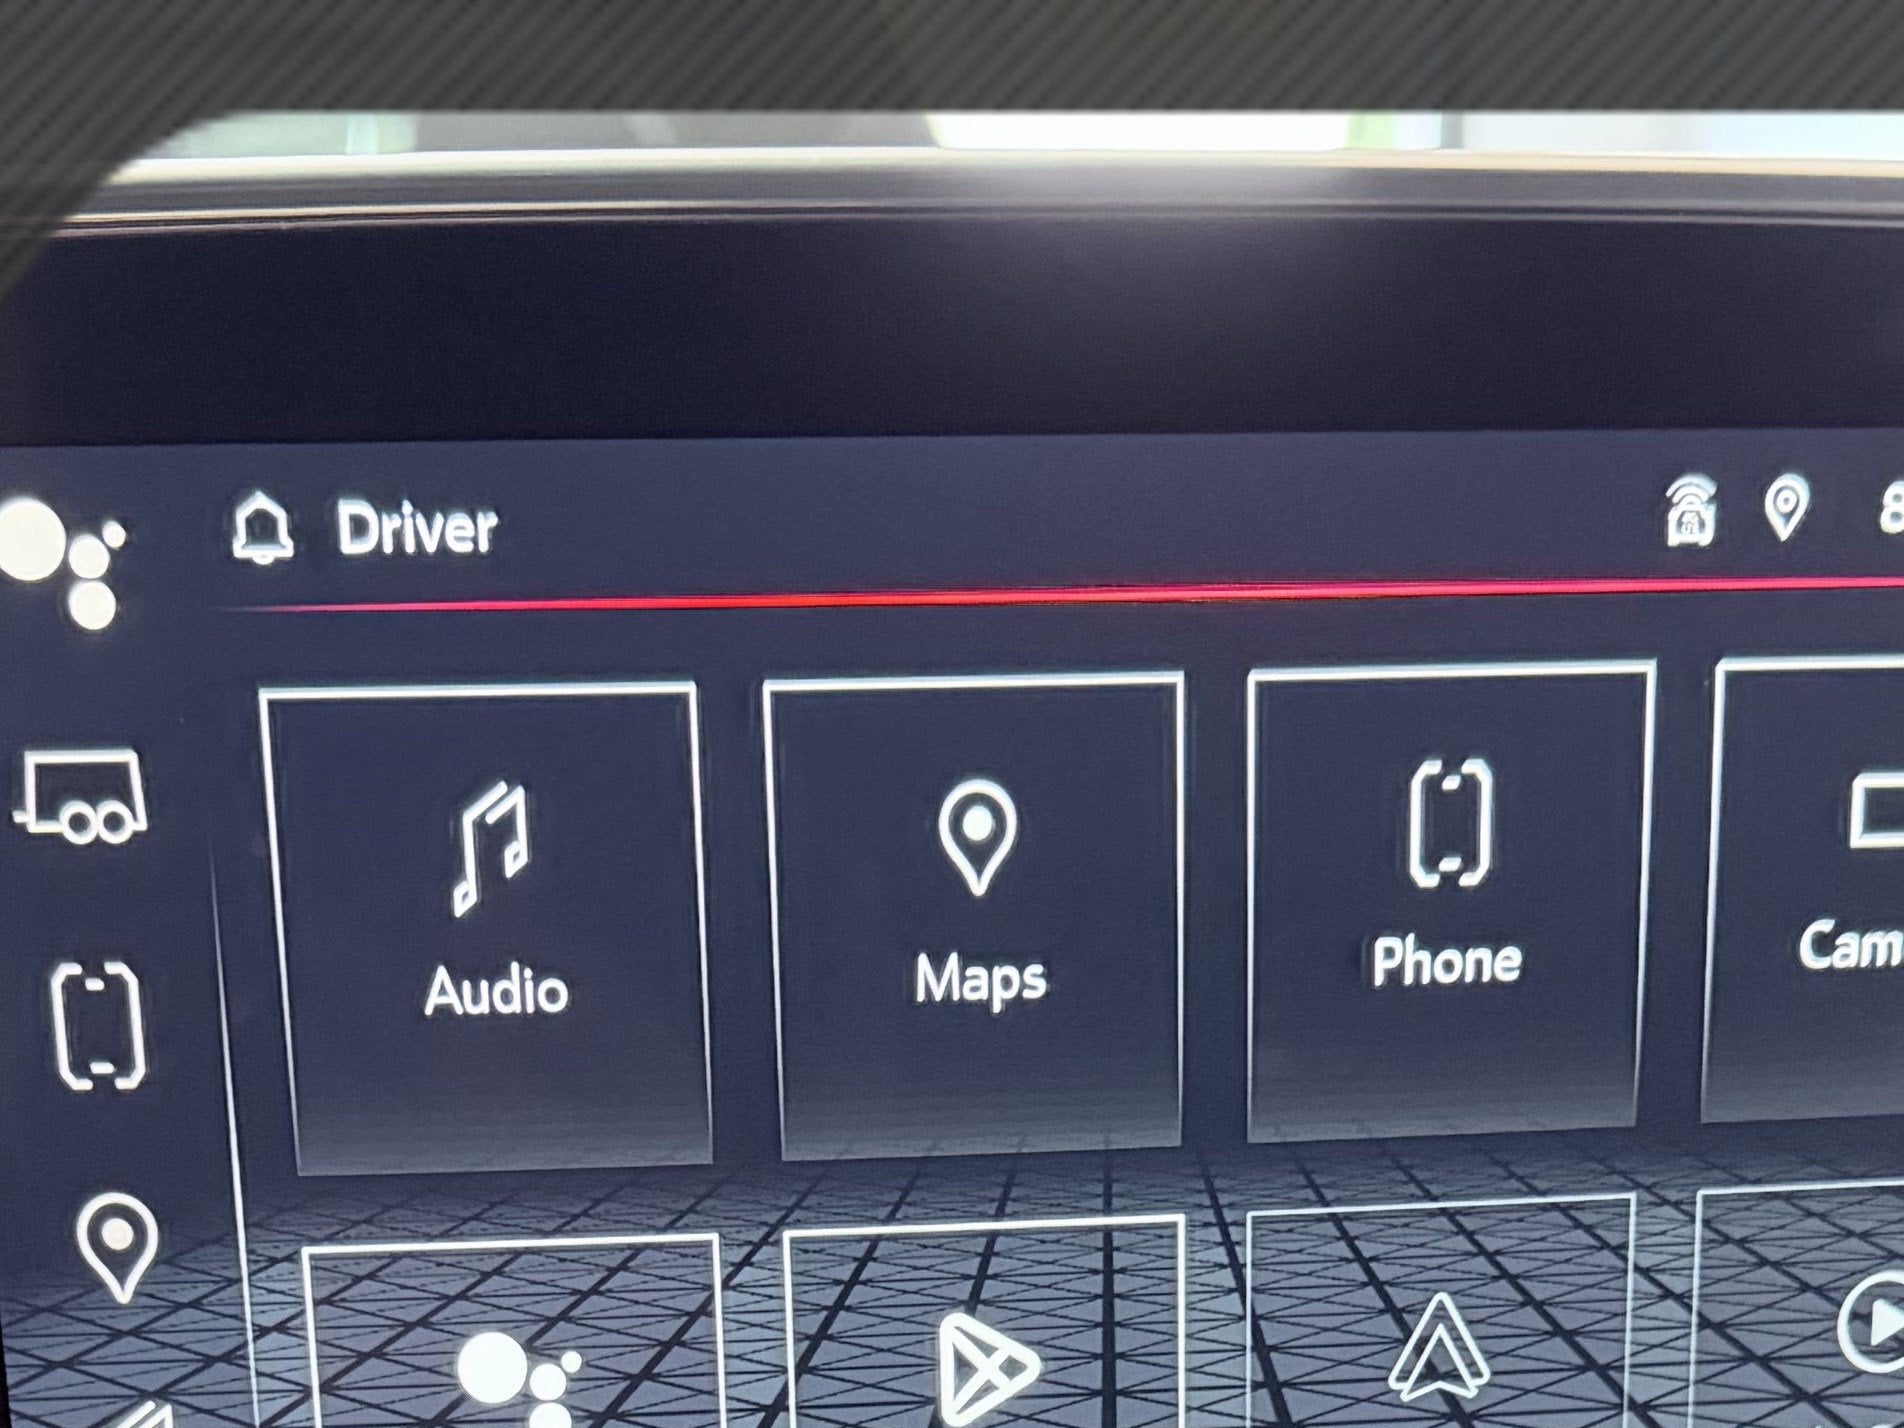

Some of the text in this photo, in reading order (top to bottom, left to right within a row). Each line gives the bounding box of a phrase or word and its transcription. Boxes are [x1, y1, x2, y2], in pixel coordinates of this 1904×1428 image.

[336, 497, 500, 556] Driver
[423, 960, 570, 1017] Audio
[915, 950, 1048, 1015] Maps
[1373, 931, 1524, 988] Phone
